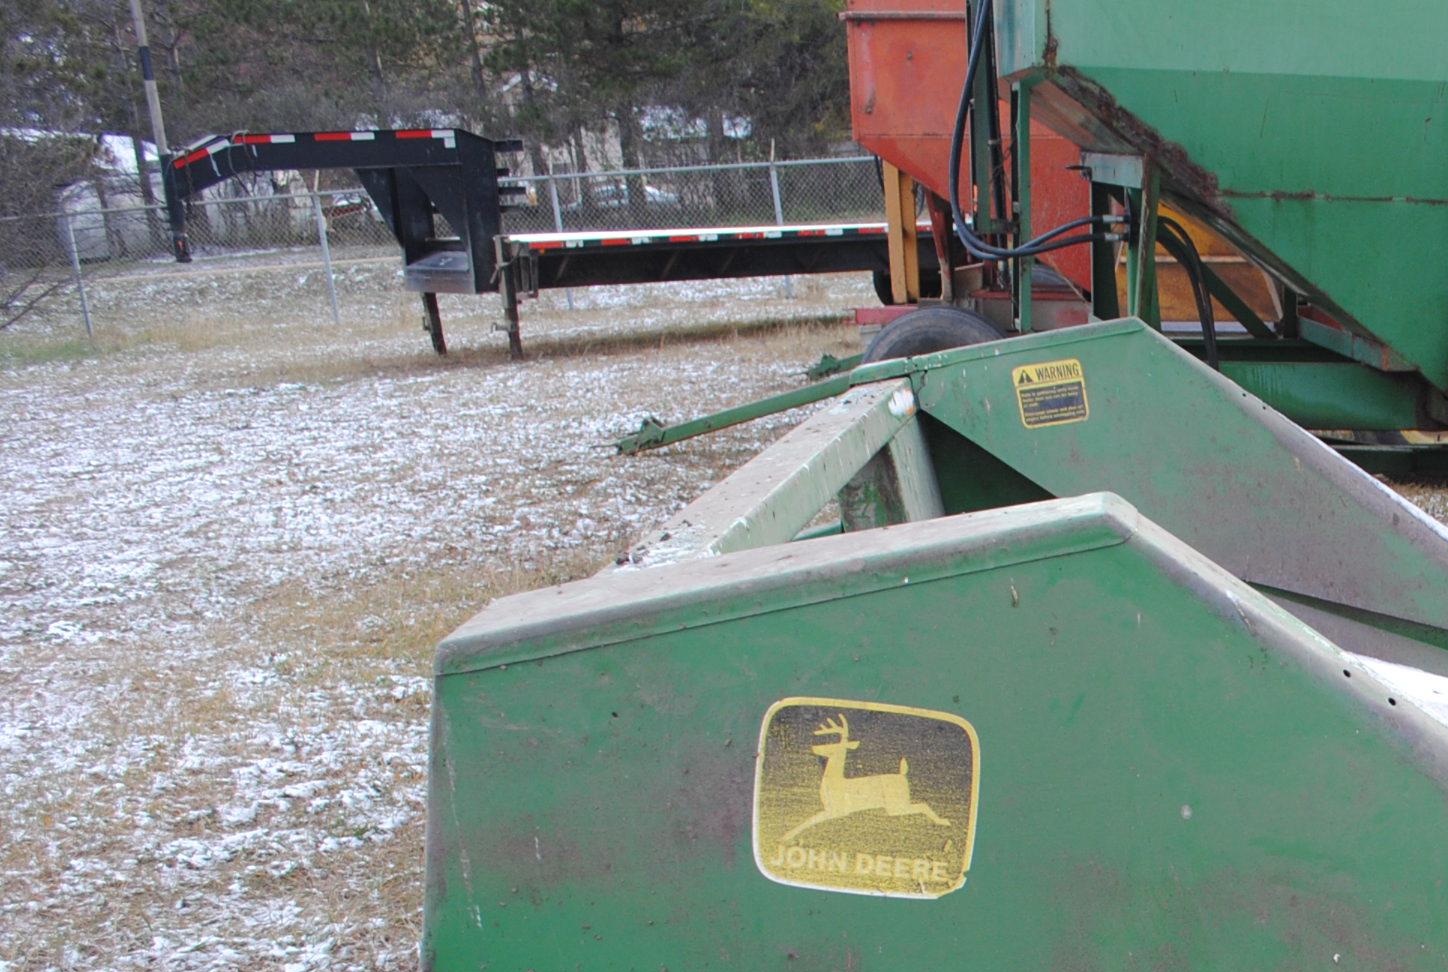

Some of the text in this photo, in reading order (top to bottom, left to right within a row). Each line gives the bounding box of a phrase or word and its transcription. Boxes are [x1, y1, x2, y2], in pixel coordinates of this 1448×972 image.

[1035, 363, 1080, 381] WARNING
[769, 845, 950, 881] JOHN DEERE
